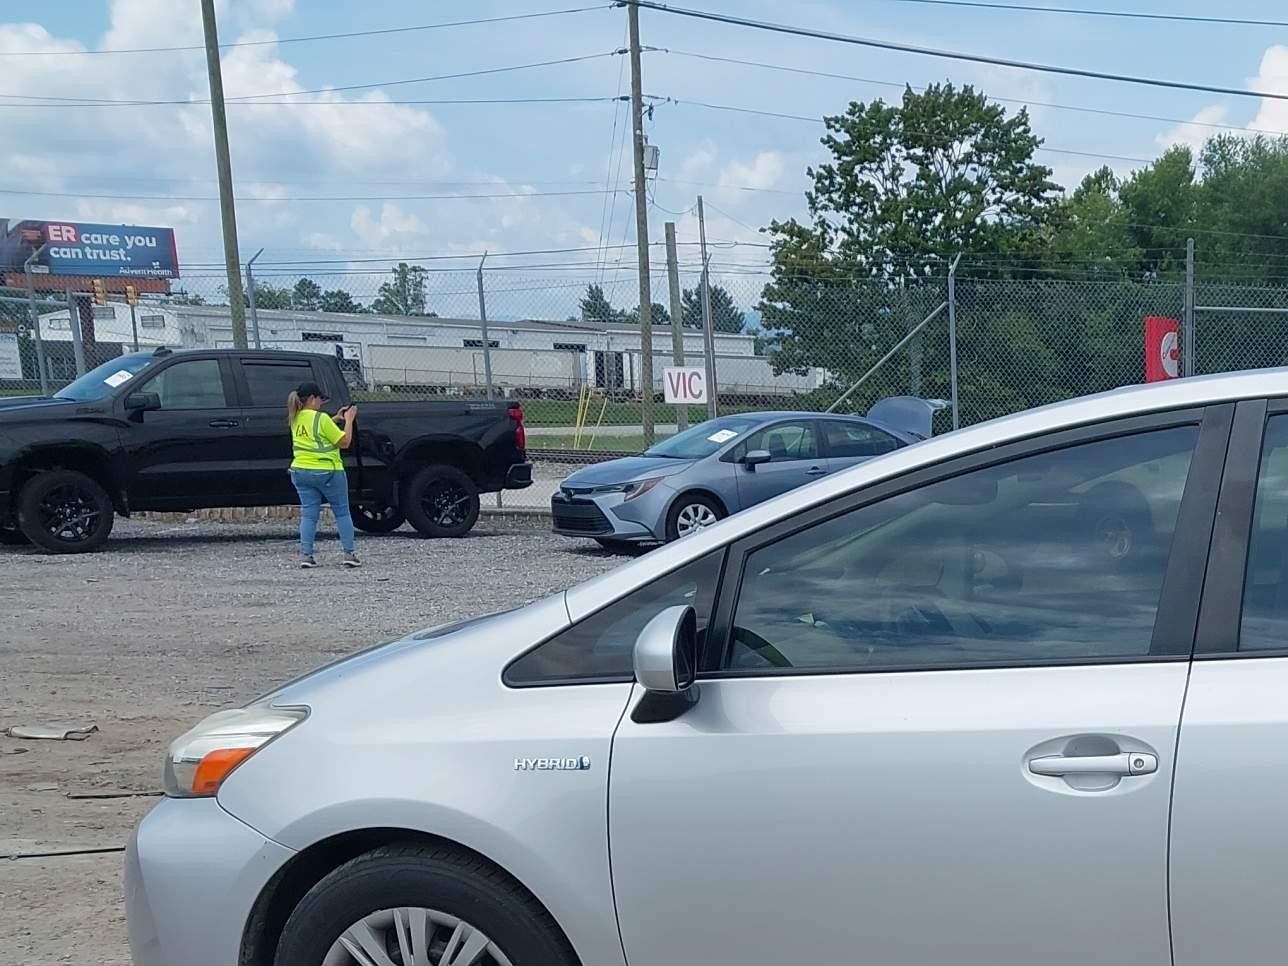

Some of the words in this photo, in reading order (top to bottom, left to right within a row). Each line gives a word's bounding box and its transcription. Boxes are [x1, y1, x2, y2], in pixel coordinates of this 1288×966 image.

[48, 225, 76, 242] ER
[80, 232, 120, 245] care
[124, 235, 157, 249] you
[49, 247, 83, 260] can
[85, 247, 131, 261] trust.
[667, 371, 703, 400] VIC
[513, 757, 578, 771] HYBRID
